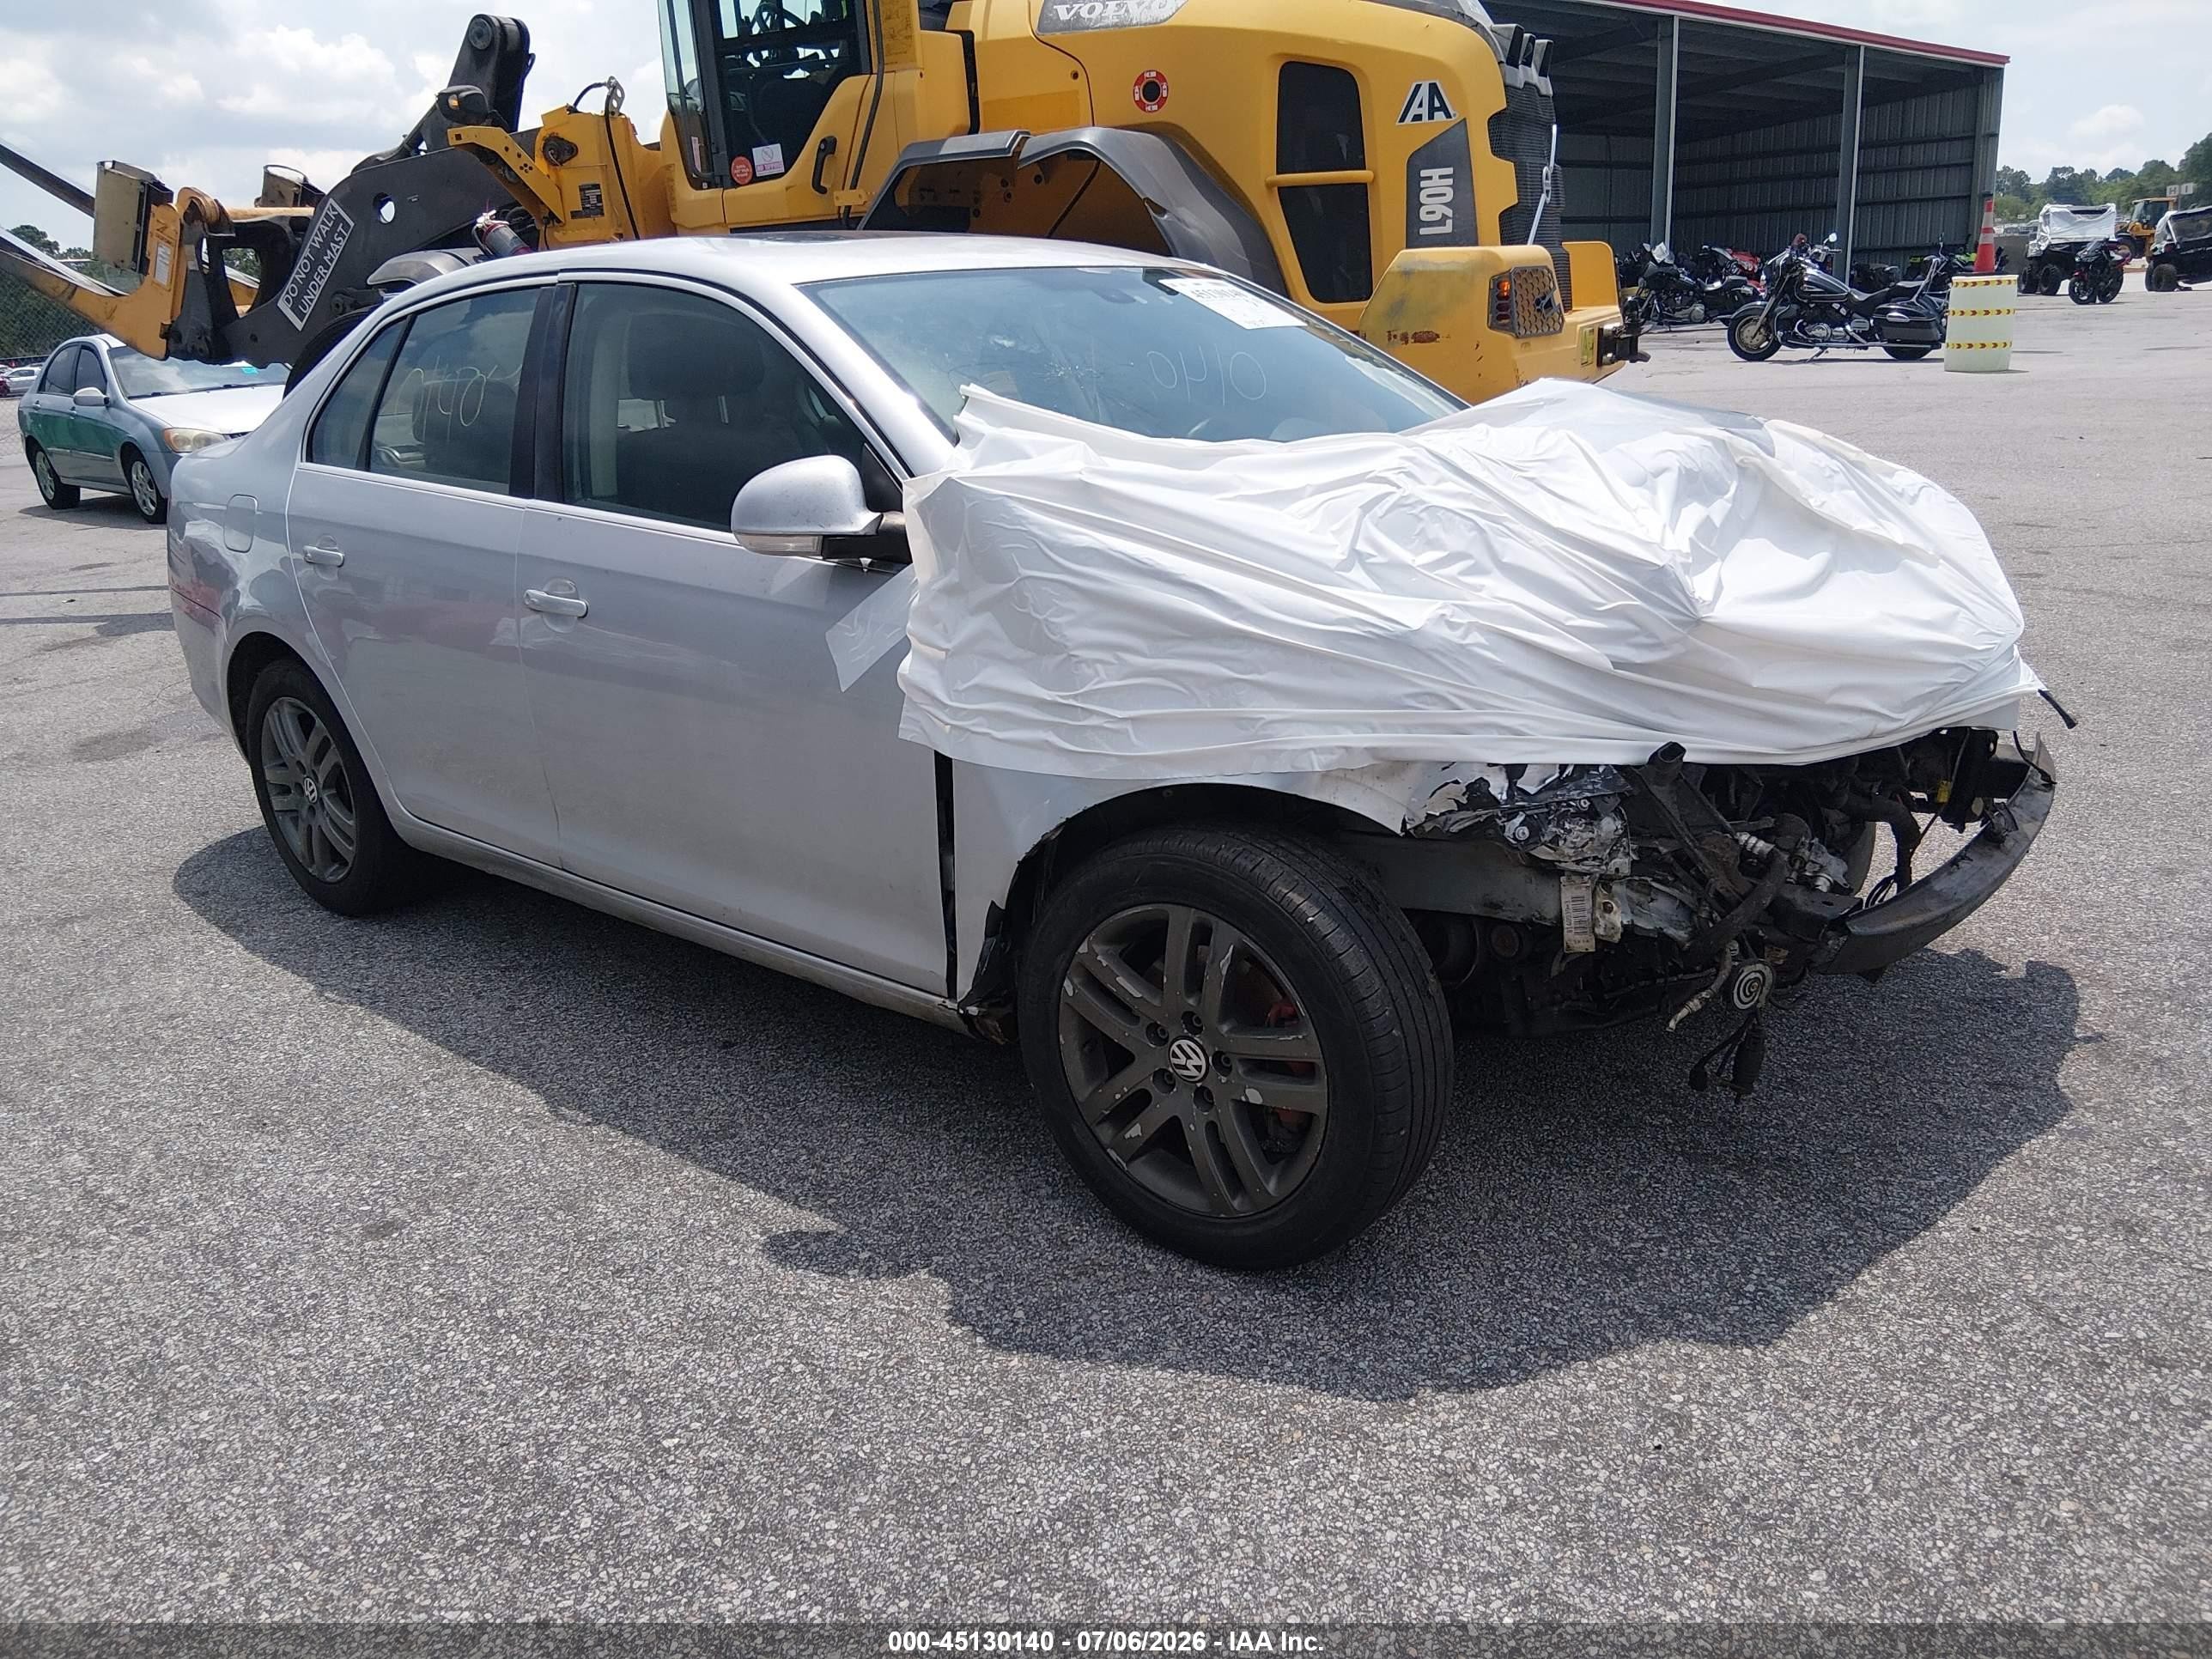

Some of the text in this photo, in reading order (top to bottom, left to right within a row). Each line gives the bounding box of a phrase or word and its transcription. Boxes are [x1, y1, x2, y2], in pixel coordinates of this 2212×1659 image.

[1054, 0, 1174, 21] VOLVO
[283, 205, 338, 308] DO NOT WALK
[298, 222, 349, 313] UNDER MAST
